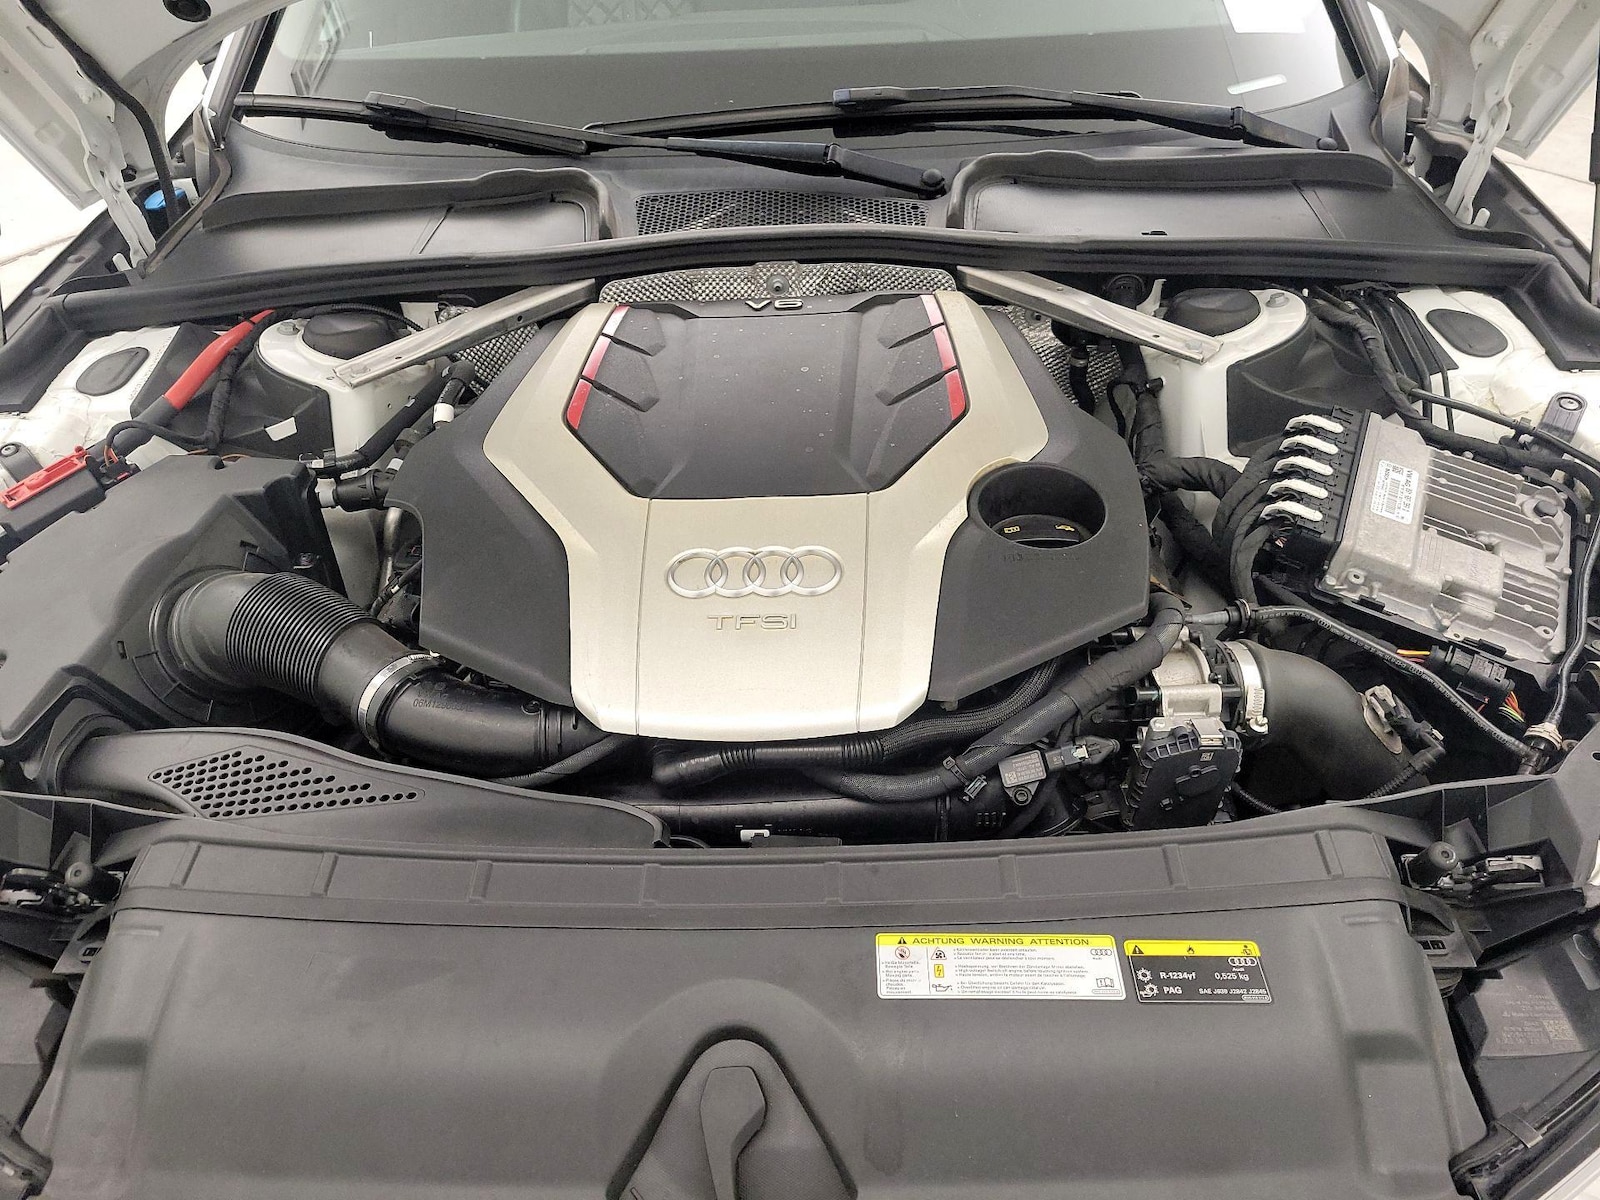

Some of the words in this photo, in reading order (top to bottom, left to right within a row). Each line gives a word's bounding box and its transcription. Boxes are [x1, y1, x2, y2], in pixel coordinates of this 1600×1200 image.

[744, 298, 803, 311] V6
[707, 613, 797, 630] TFSI
[912, 937, 965, 945] ACHTUNG
[971, 937, 1024, 945] WARNING
[1030, 938, 1090, 946] ATTENTION
[1160, 971, 1196, 981] R-1234yf
[1214, 972, 1238, 981] 0,525
[1238, 972, 1250, 982] kg
[1163, 986, 1182, 994] PAG
